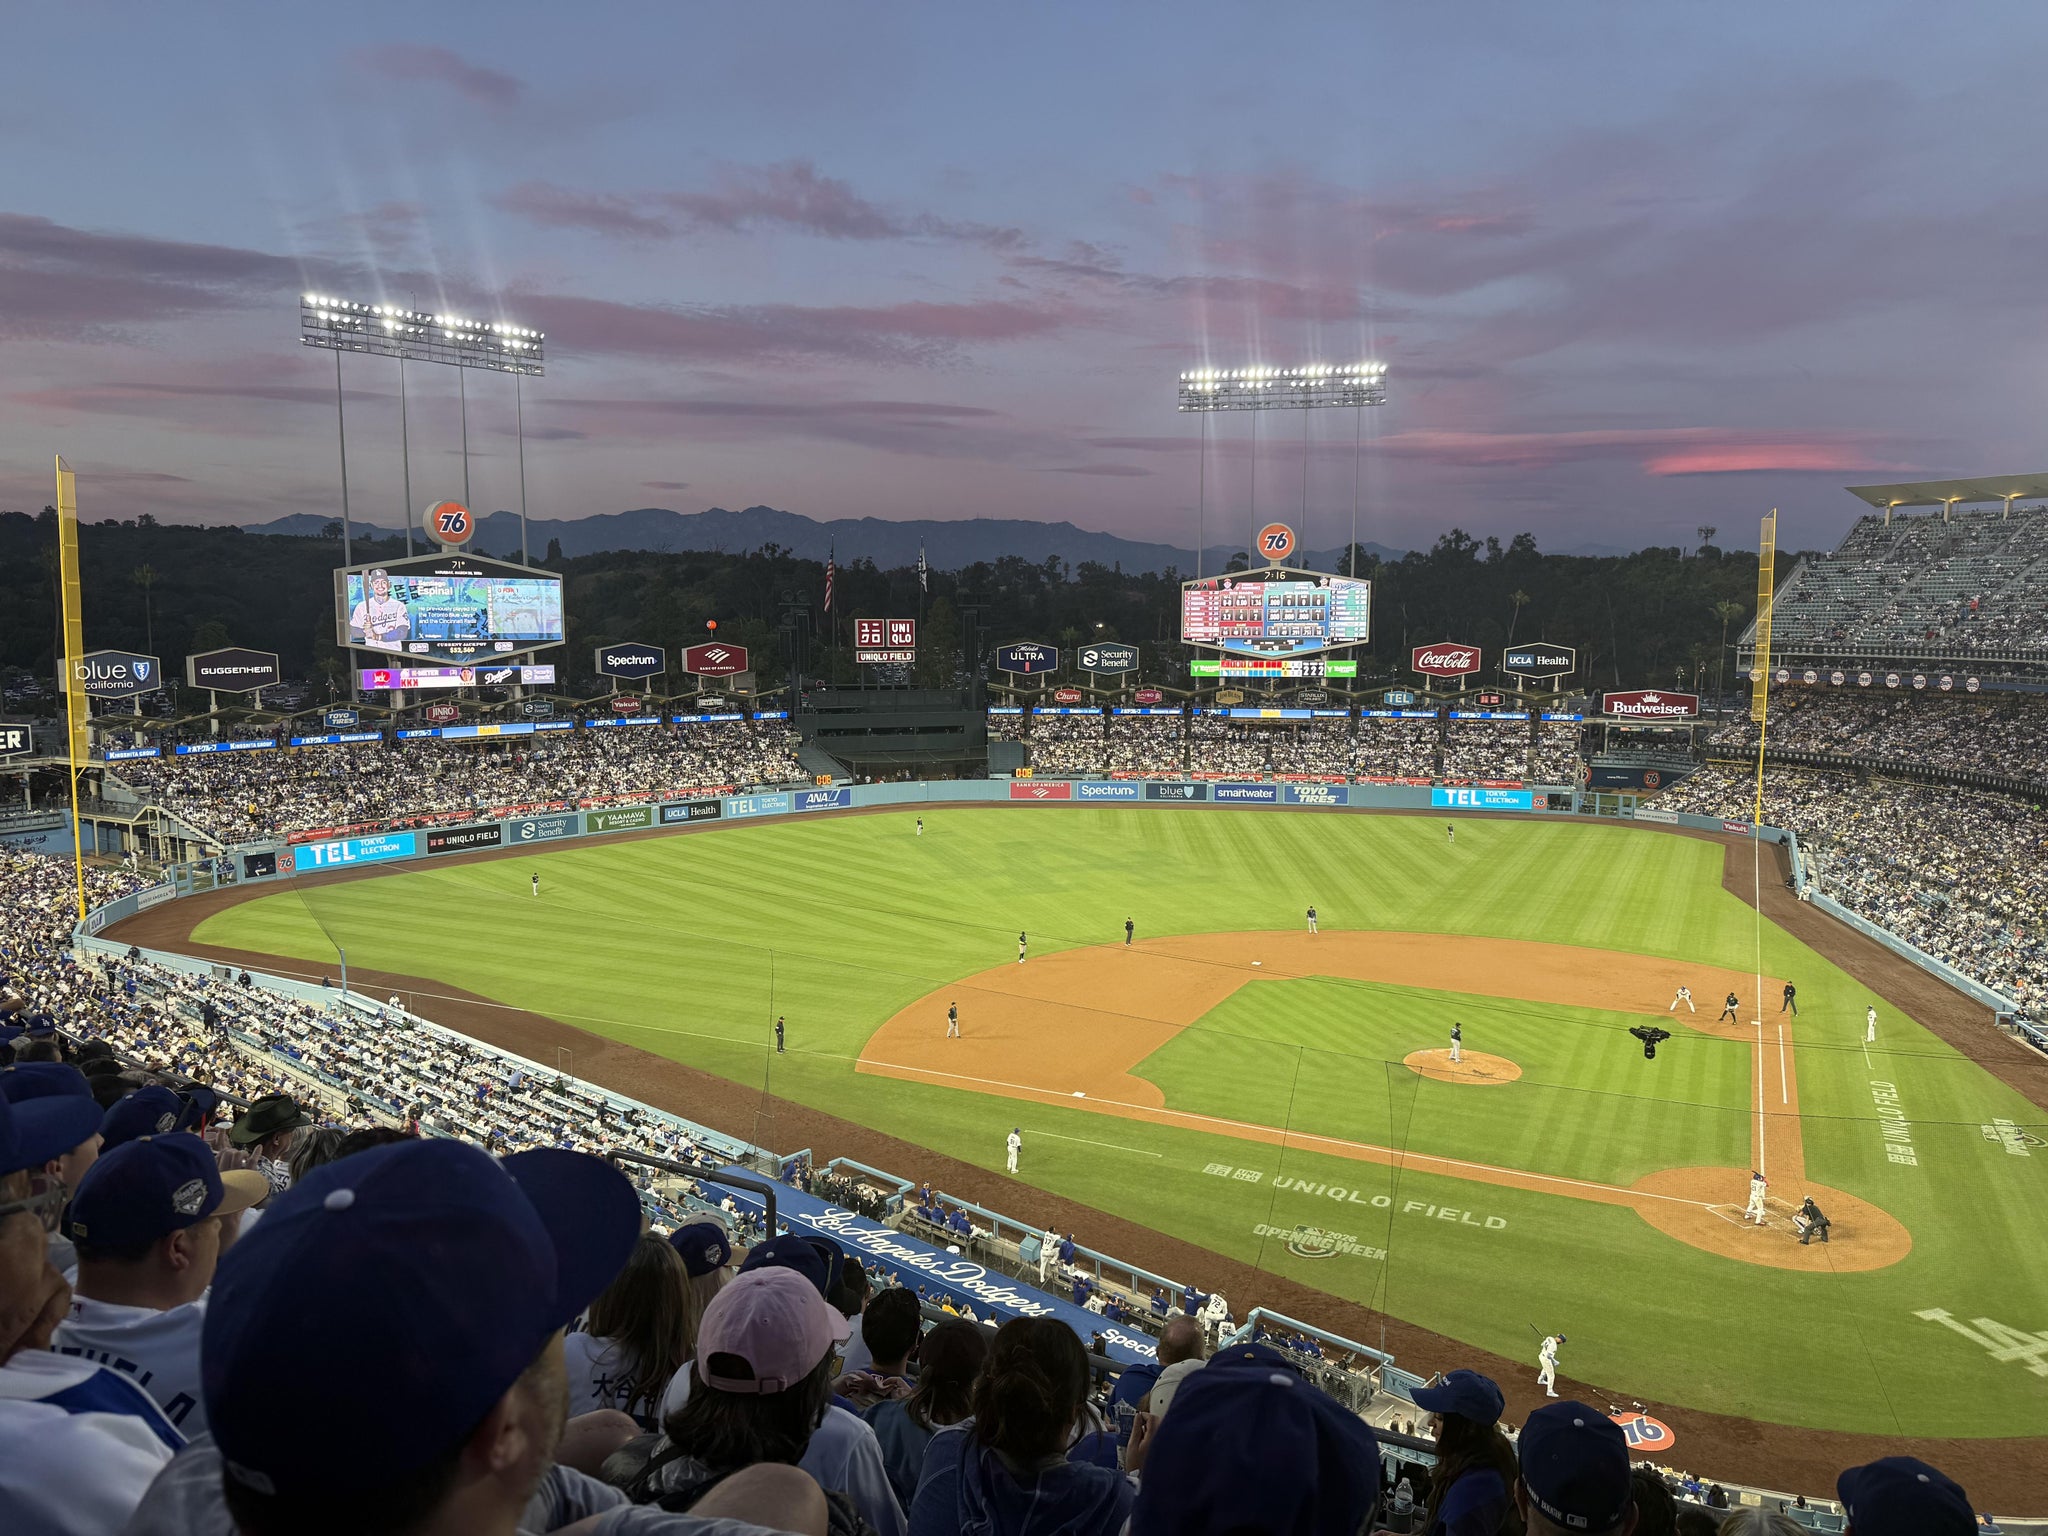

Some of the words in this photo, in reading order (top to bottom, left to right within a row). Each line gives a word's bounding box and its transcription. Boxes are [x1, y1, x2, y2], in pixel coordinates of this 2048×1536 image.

[438, 512, 466, 533] 76
[1265, 532, 1288, 550] 76
[451, 560, 466, 569] 71°
[1264, 571, 1286, 580] 7:16
[418, 586, 453, 596] Espinal
[891, 623, 910, 633] UNI
[891, 633, 912, 645] QLO
[860, 653, 888, 662] UNIQLO
[890, 653, 912, 661] FIELD
[1010, 652, 1044, 661] ULTRA
[1101, 649, 1133, 660] Security
[1418, 650, 1474, 669] Coca-Cola
[607, 655, 655, 667] Spectrum
[1101, 658, 1129, 667] Benefit
[1509, 656, 1532, 665] UCLA
[1537, 656, 1569, 666] Health
[74, 660, 127, 680] blue
[201, 666, 272, 676] GUGGENHEIM
[1303, 666, 1309, 676] 2
[1311, 666, 1317, 676] 2
[1318, 666, 1324, 676] 2
[485, 667, 512, 684] Dodgers
[84, 680, 134, 689] california
[1055, 692, 1080, 701] Churu
[1387, 694, 1410, 703] TEL
[432, 706, 454, 716] JINRO
[230, 741, 257, 750] KINOSHITA
[109, 750, 138, 759] KINOSHITA
[1015, 768, 1033, 778] 0:08
[816, 774, 832, 785] 0:08
[1647, 773, 1659, 784] 76
[1081, 785, 1131, 797] Spectrum
[1160, 785, 1183, 796] blue
[1217, 788, 1273, 798] smartwater
[1293, 786, 1328, 795] TOYO
[806, 793, 829, 803] ANA
[1298, 793, 1336, 803] TIRES
[1445, 789, 1481, 806] TEL
[1534, 798, 1545, 807] 76
[729, 799, 757, 815] TEL
[761, 801, 787, 809] ELECTRON
[667, 807, 686, 817] UCLA
[690, 805, 716, 816] Health
[538, 818, 567, 829] Security
[1724, 822, 1748, 833] Yakult
[538, 828, 563, 837] Benefit
[360, 837, 386, 846] TOKYO
[446, 833, 475, 845] UNIQLO
[476, 831, 499, 841] FIELD
[310, 842, 357, 865] TEL
[360, 843, 400, 855] ELECTRON
[279, 857, 293, 867] 76
[1869, 1081, 1901, 1107] FIELD
[1876, 1107, 1912, 1142] UNIQLO
[1272, 1176, 1392, 1208] UNIQLO
[1403, 1200, 1508, 1230] FIELD
[1253, 1223, 1335, 1250] OPENING
[1335, 1240, 1389, 1261] WEEK
[1325, 1231, 1358, 1243] 2026
[799, 1208, 855, 1236] Los
[843, 1228, 944, 1272] Angeles
[930, 1261, 1055, 1317] Dodgers
[1212, 1298, 1221, 1308] 72
[1618, 1416, 1666, 1447] 76
